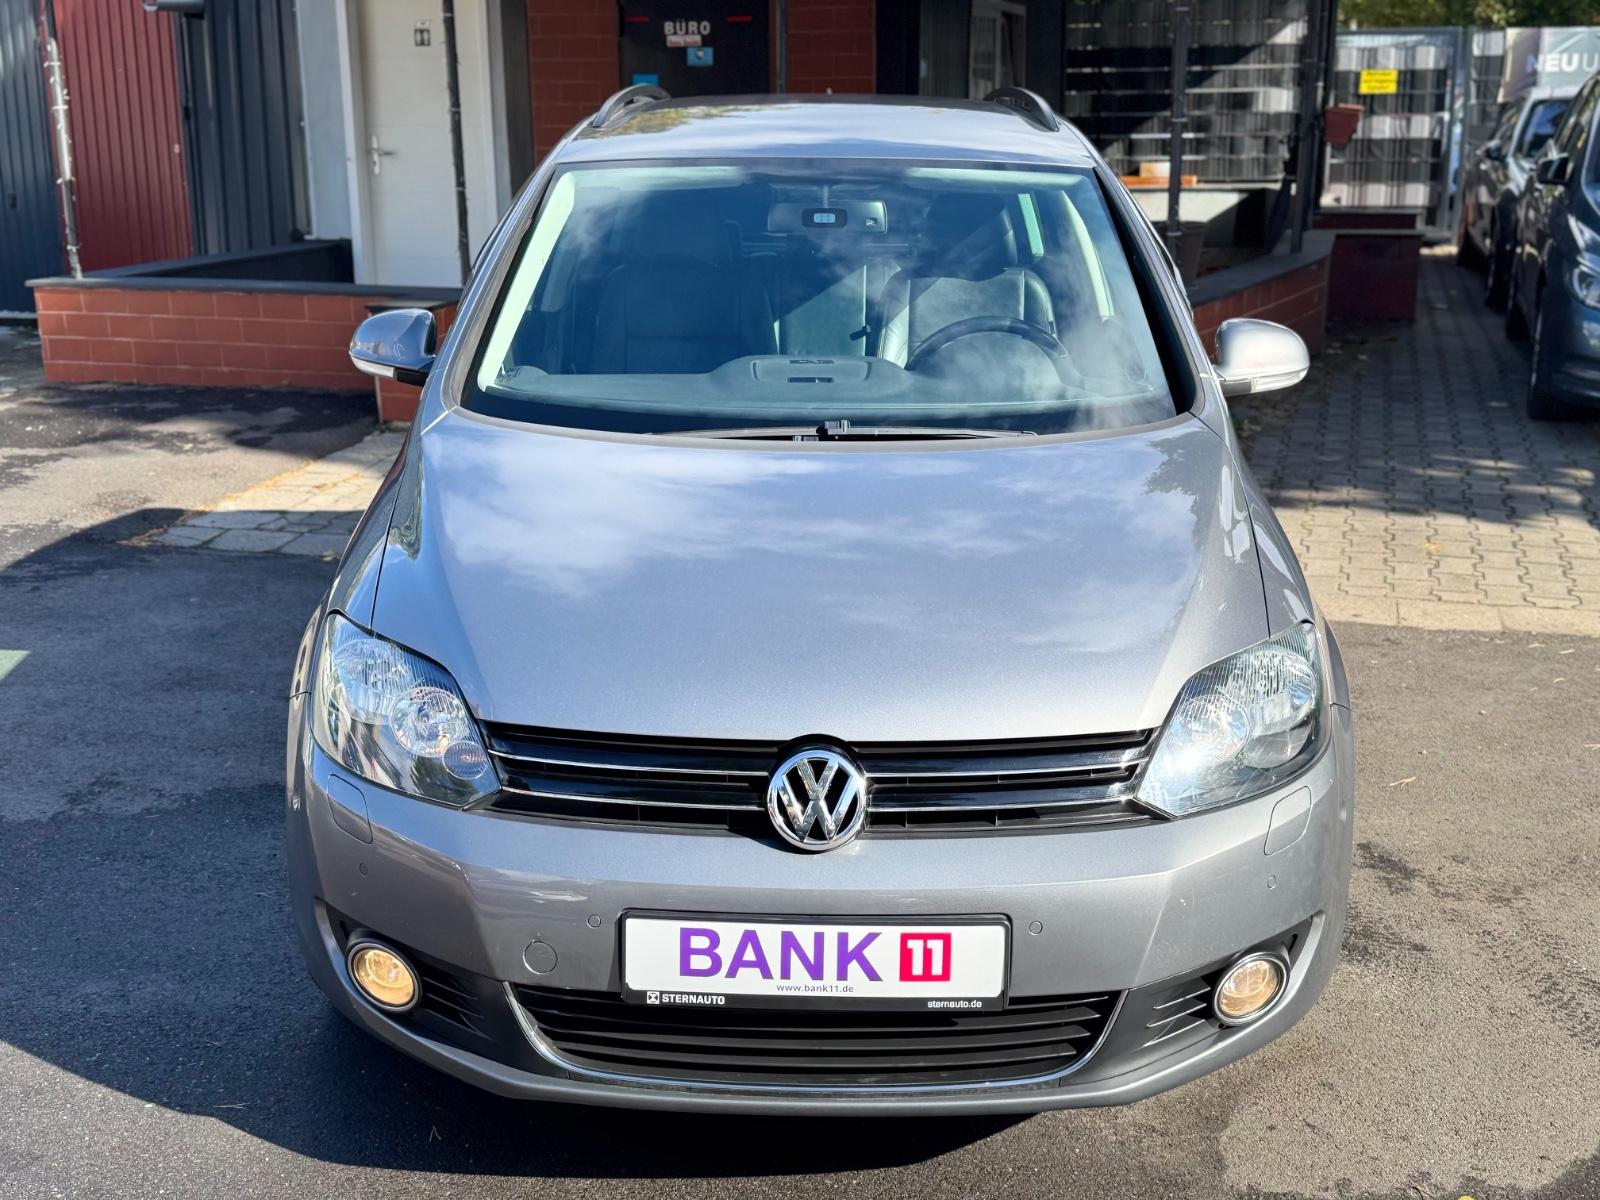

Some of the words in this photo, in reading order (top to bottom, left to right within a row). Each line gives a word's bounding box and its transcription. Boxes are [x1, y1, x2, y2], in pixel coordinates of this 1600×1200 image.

[664, 19, 711, 35] BÜRO
[1525, 53, 1579, 73] NEU
[679, 927, 883, 982] BANK
[906, 938, 945, 977] 11
[776, 984, 854, 993] www.bank11.de
[661, 993, 726, 1005] STERNAUTO
[927, 1000, 983, 1008] sternauto.de
